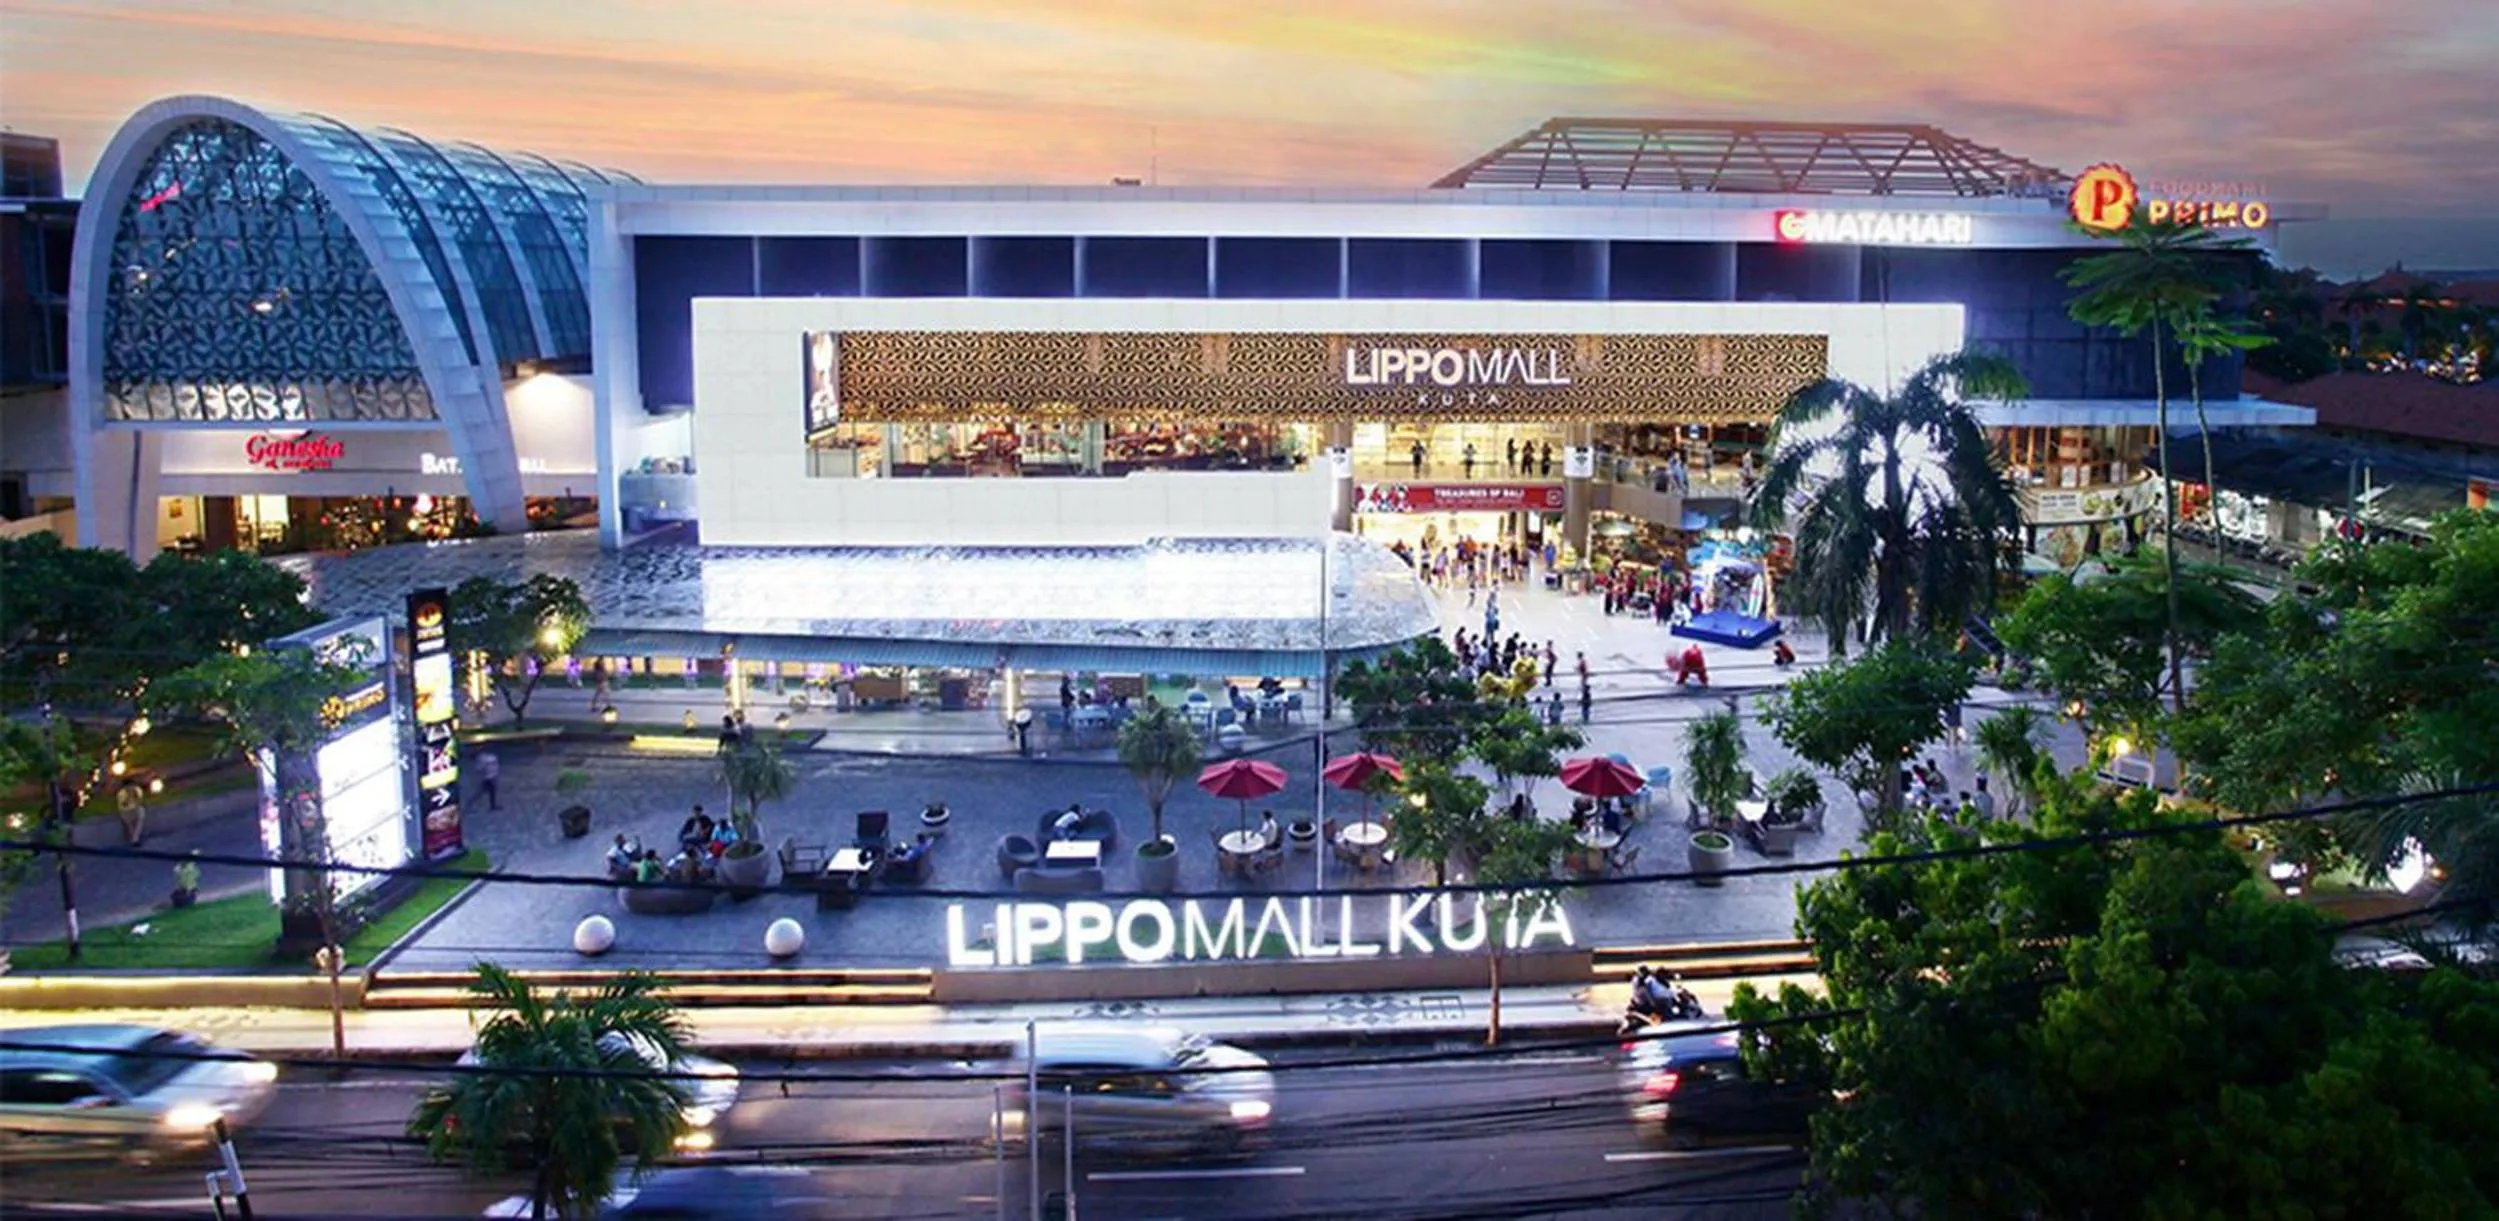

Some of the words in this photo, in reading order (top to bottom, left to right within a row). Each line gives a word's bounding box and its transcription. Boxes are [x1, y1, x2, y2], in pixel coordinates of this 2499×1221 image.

[2091, 180, 2123, 221] P
[2149, 199, 2268, 228] PRIMO
[1803, 211, 1973, 243] MATAHARI
[1346, 348, 1464, 386] LIPPO
[1468, 348, 1571, 384] MALL
[1417, 393, 1500, 406] KUTA
[244, 435, 345, 464] Ganesha
[420, 452, 463, 474] BAT
[946, 898, 1176, 966] LIPPO
[1183, 895, 1381, 960] MALL
[1388, 888, 1576, 953] KUTA
